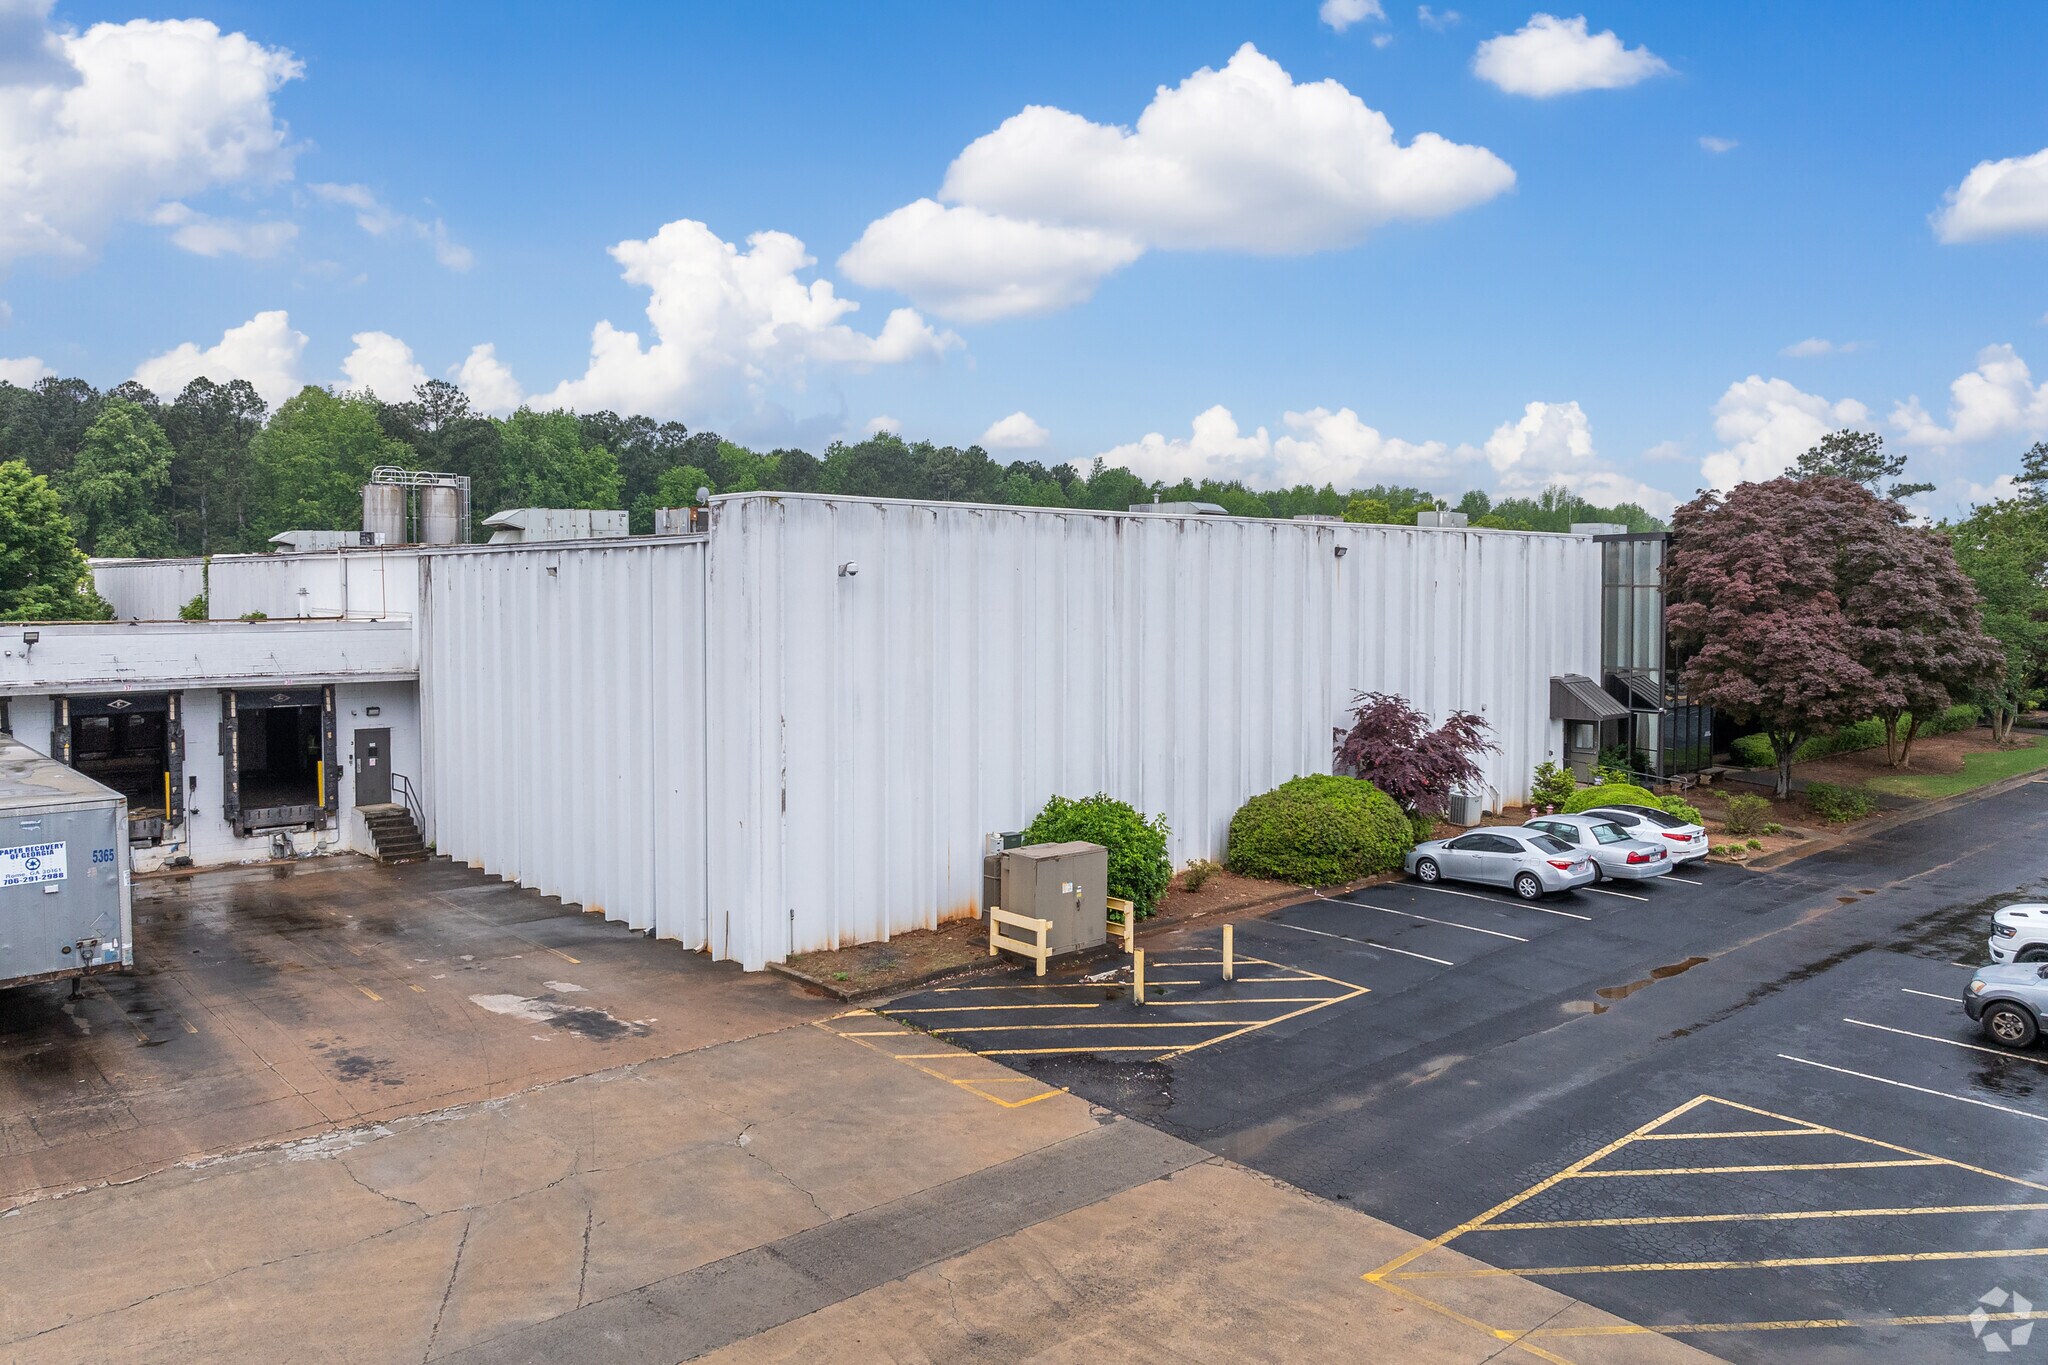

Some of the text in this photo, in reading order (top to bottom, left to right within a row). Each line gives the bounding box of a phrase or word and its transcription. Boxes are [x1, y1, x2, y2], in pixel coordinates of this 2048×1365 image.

[0, 843, 64, 856] PAPER RECOVERY
[21, 849, 55, 859] GEORGIA
[92, 848, 115, 863] 5365
